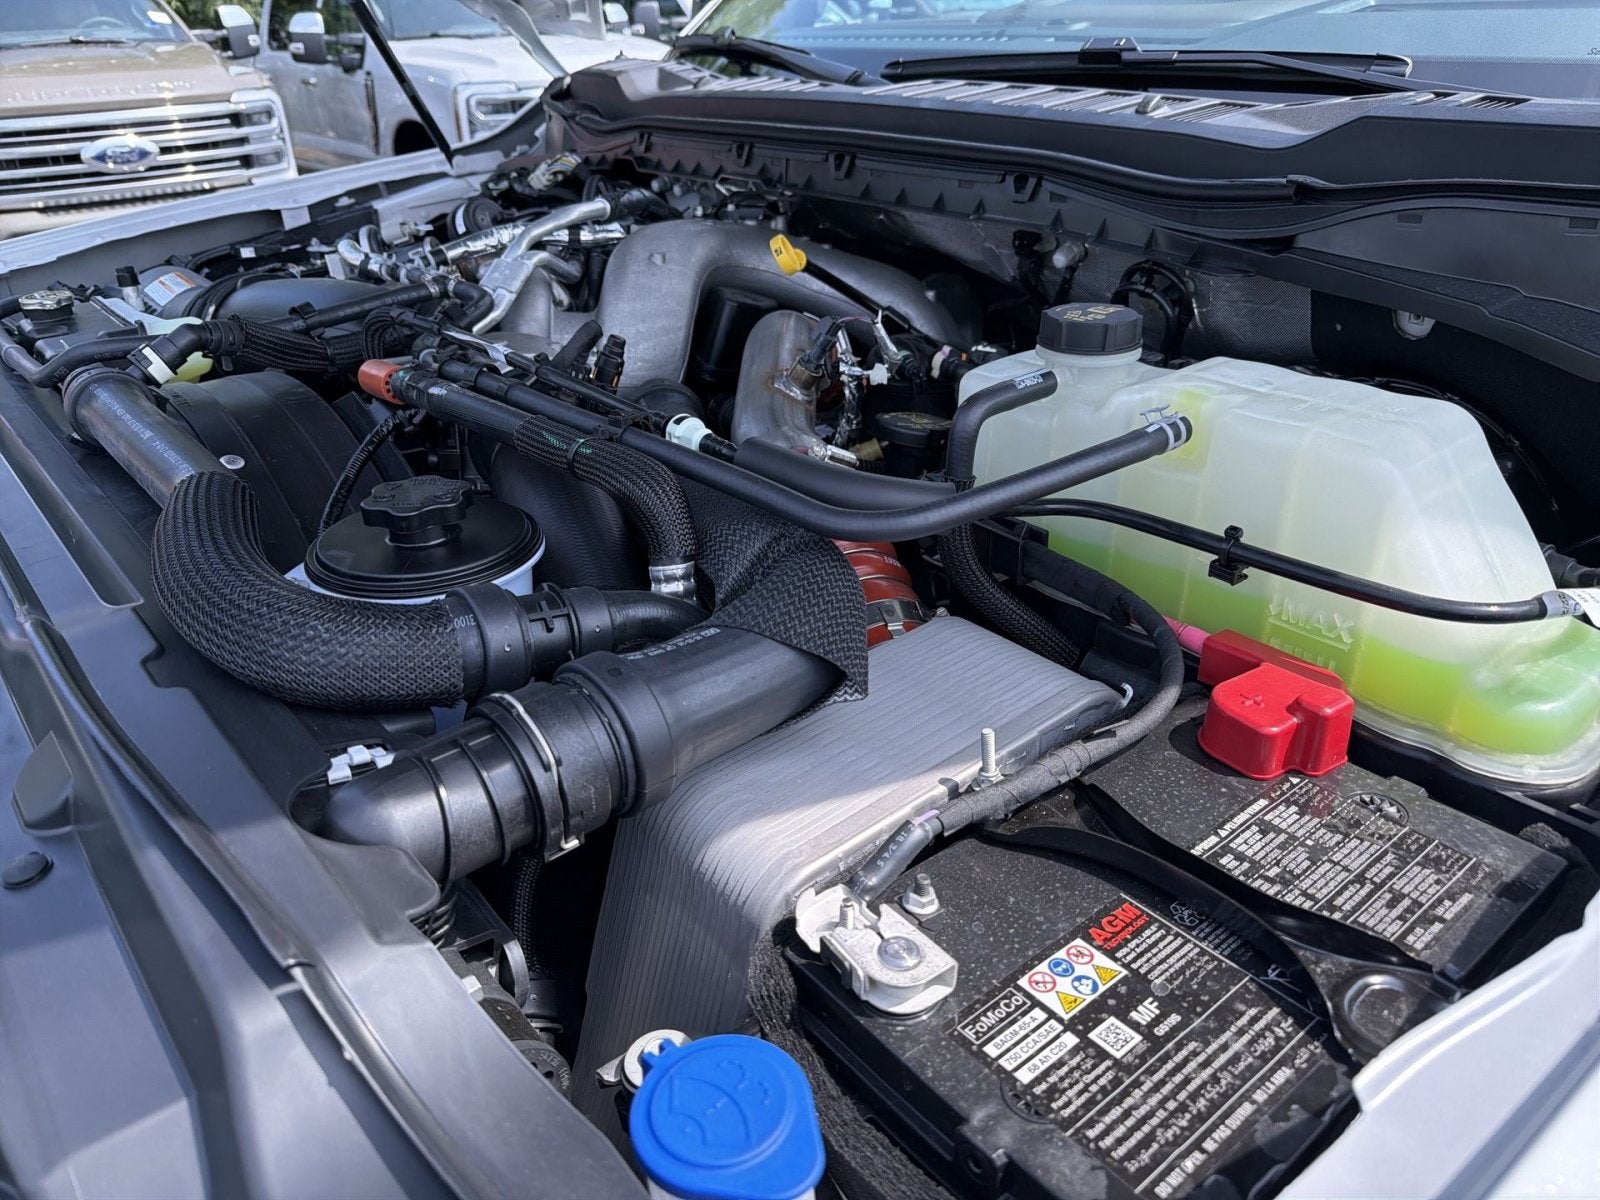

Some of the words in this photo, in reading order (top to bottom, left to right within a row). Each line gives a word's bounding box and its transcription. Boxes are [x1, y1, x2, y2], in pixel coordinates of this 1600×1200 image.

[1281, 597, 1354, 644] MAX
[1089, 902, 1142, 945] AGM
[1104, 915, 1149, 949] TECHNOLOGY
[964, 995, 1023, 1039] FoMoCo
[1130, 997, 1160, 1025] MF
[1154, 1013, 1182, 1036] G519S
[993, 1016, 1039, 1050] BAGM-65-A
[1004, 1051, 1022, 1066] 750
[1019, 1023, 1058, 1054] CCA/SAE
[1038, 1054, 1052, 1066] Ah
[1049, 1041, 1068, 1056] C20
[1154, 1181, 1173, 1198] DO
[1165, 1167, 1186, 1187] NOT
[1202, 1137, 1219, 1152] NE
[1211, 1124, 1232, 1142] PAS
[1252, 1089, 1268, 1103] NO
[1261, 1081, 1277, 1095] LA
